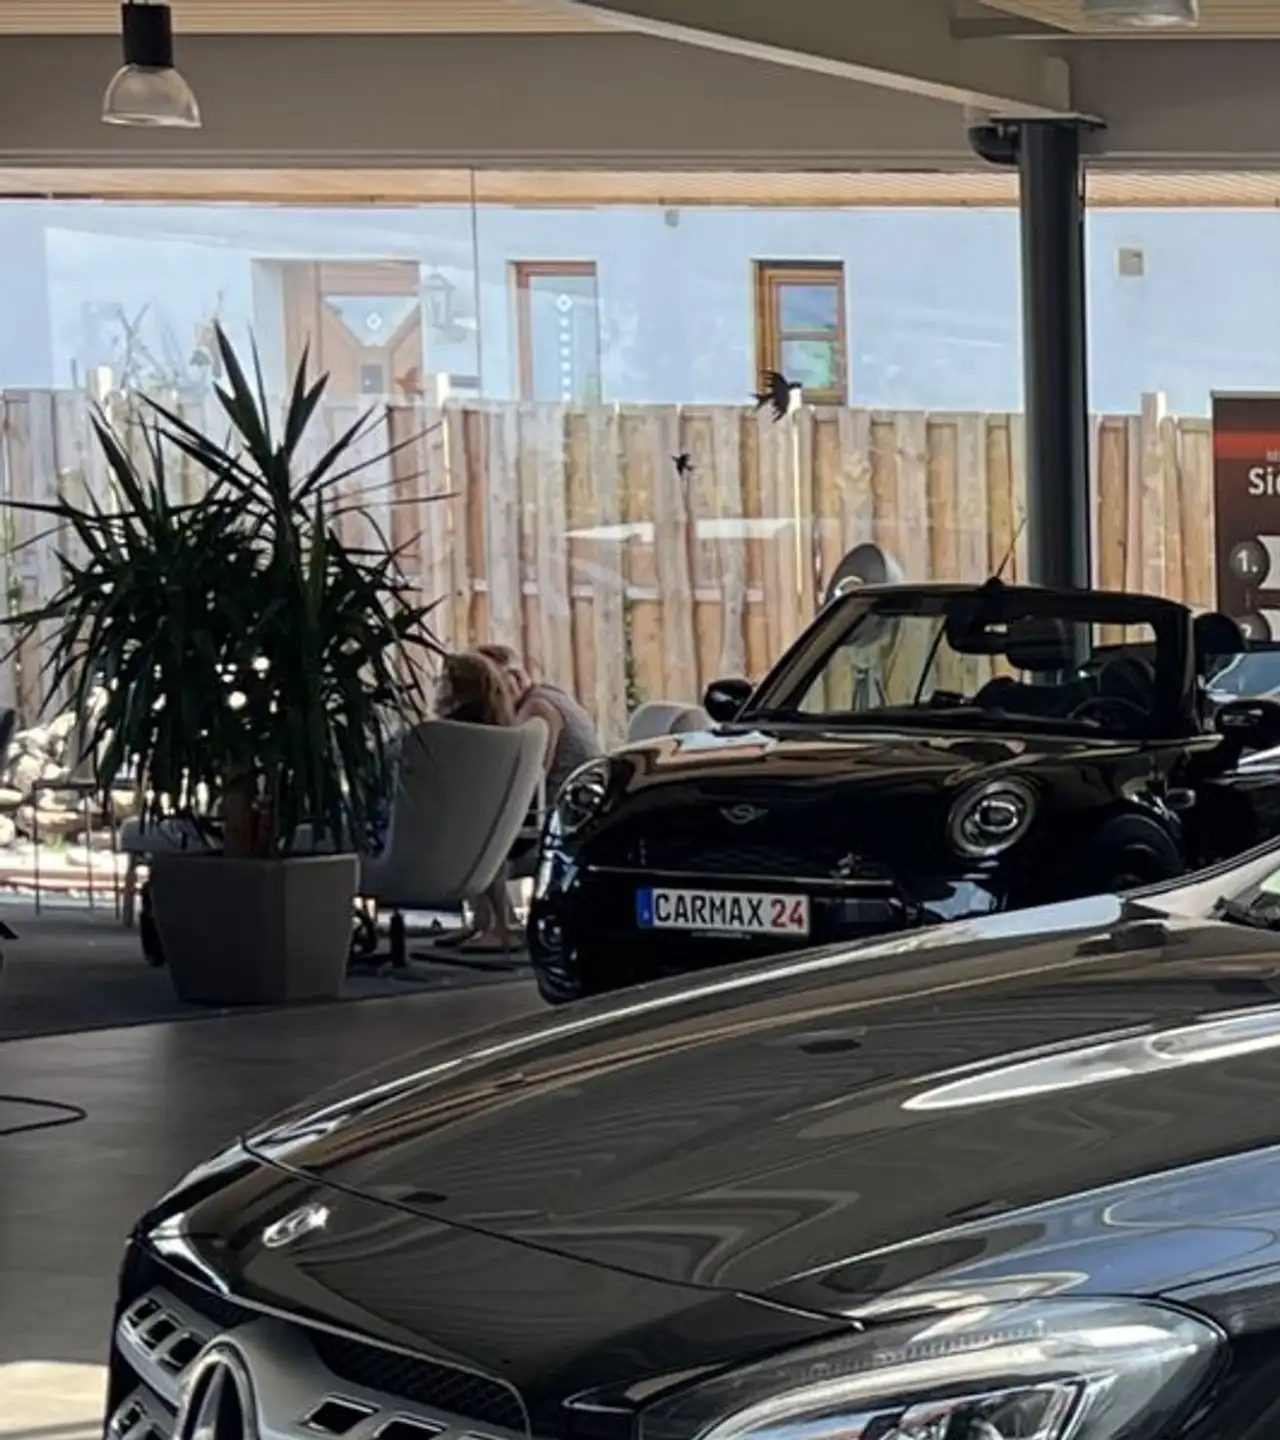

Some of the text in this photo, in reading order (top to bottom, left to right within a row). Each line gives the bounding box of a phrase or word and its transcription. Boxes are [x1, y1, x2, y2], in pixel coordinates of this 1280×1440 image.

[1237, 549, 1258, 573] 1.
[654, 893, 805, 928] CARMAX 24
